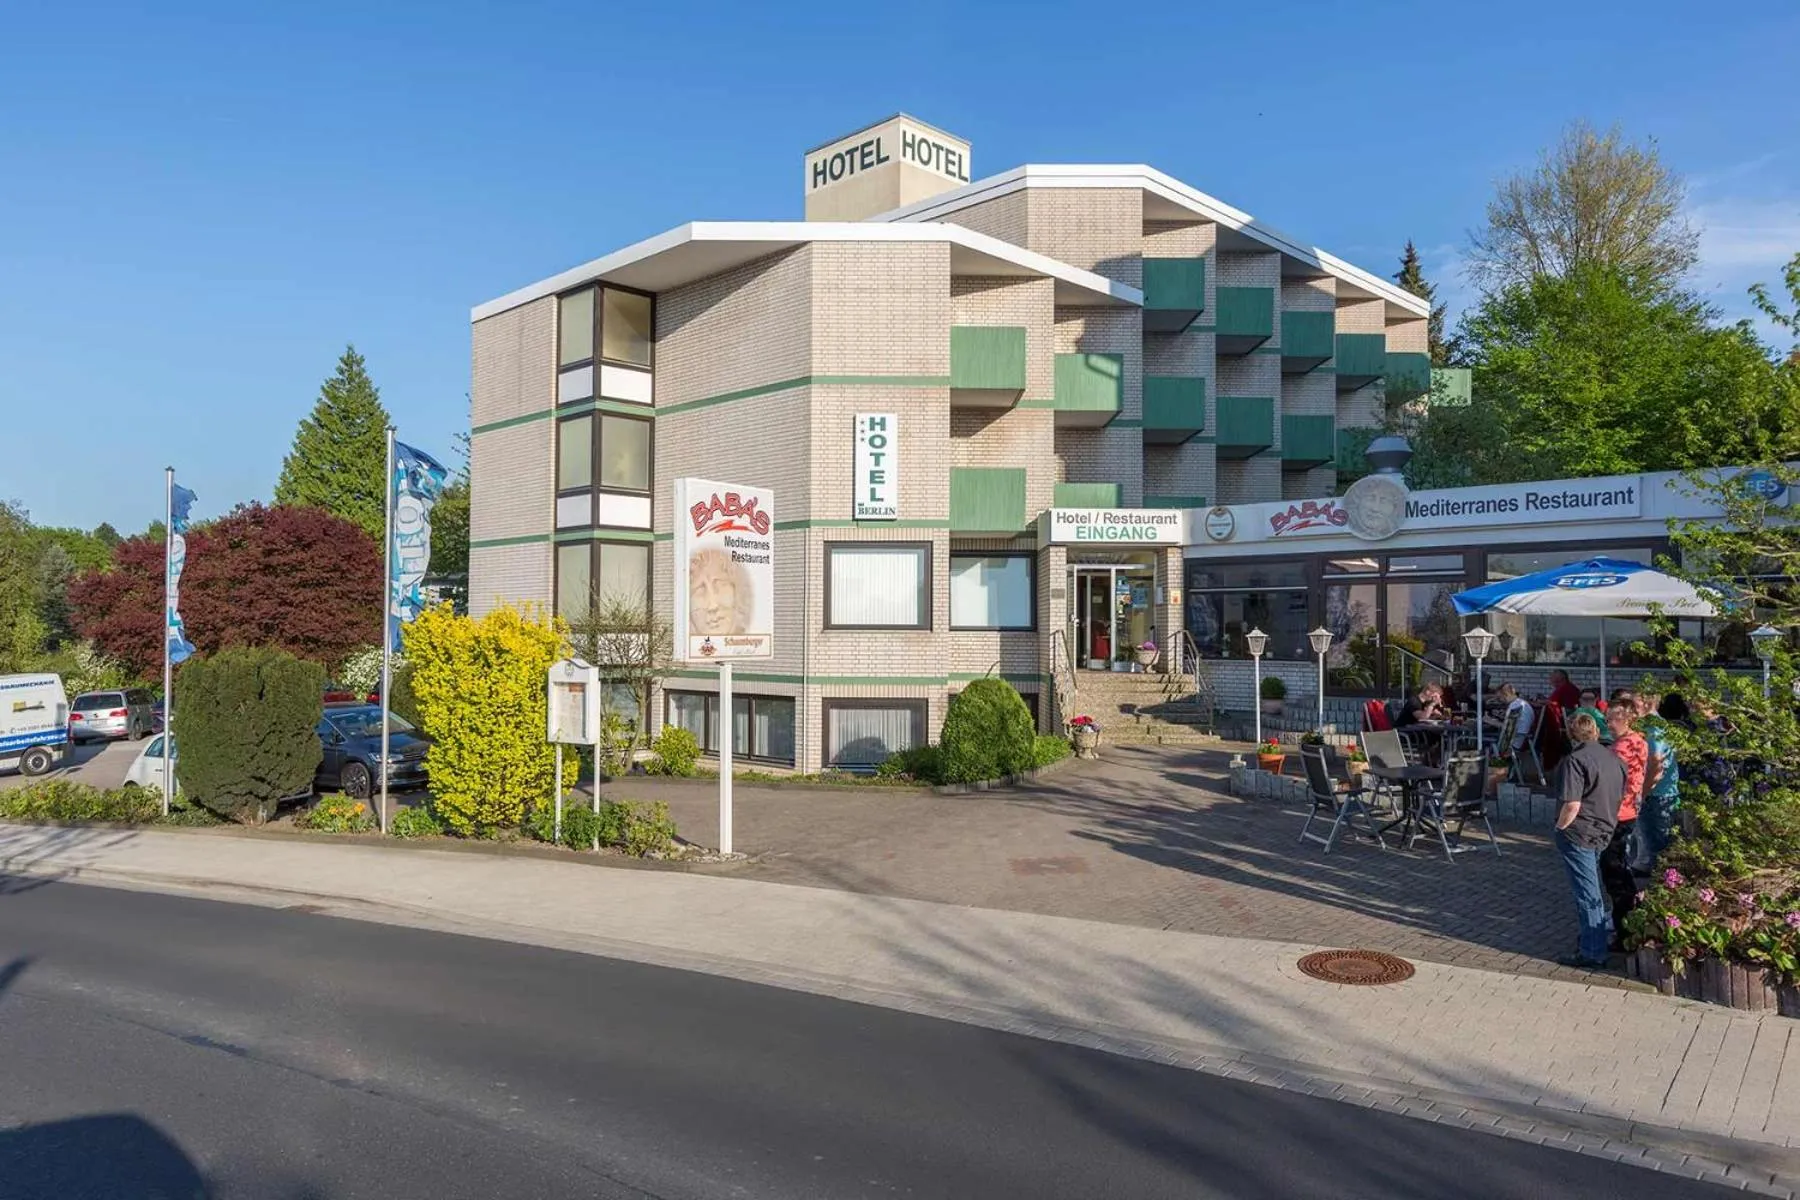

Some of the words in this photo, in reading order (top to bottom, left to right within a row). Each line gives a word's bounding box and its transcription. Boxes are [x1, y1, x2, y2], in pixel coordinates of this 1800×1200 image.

[813, 136, 890, 188] HOTEL
[902, 130, 969, 182] HOTEL
[868, 417, 887, 502] HOTEL
[1404, 499, 1519, 519] Mediterranes
[1525, 487, 1634, 511] Restaurant
[690, 492, 770, 536] BABA'S
[858, 507, 896, 515] BERLIN
[1056, 512, 1091, 524] Hotel
[1103, 512, 1178, 525] Restaurant
[1076, 526, 1158, 540] EINGANG
[724, 535, 770, 550] Mediterranes
[731, 550, 770, 564] Restaurant
[1557, 577, 1617, 585] EFES
